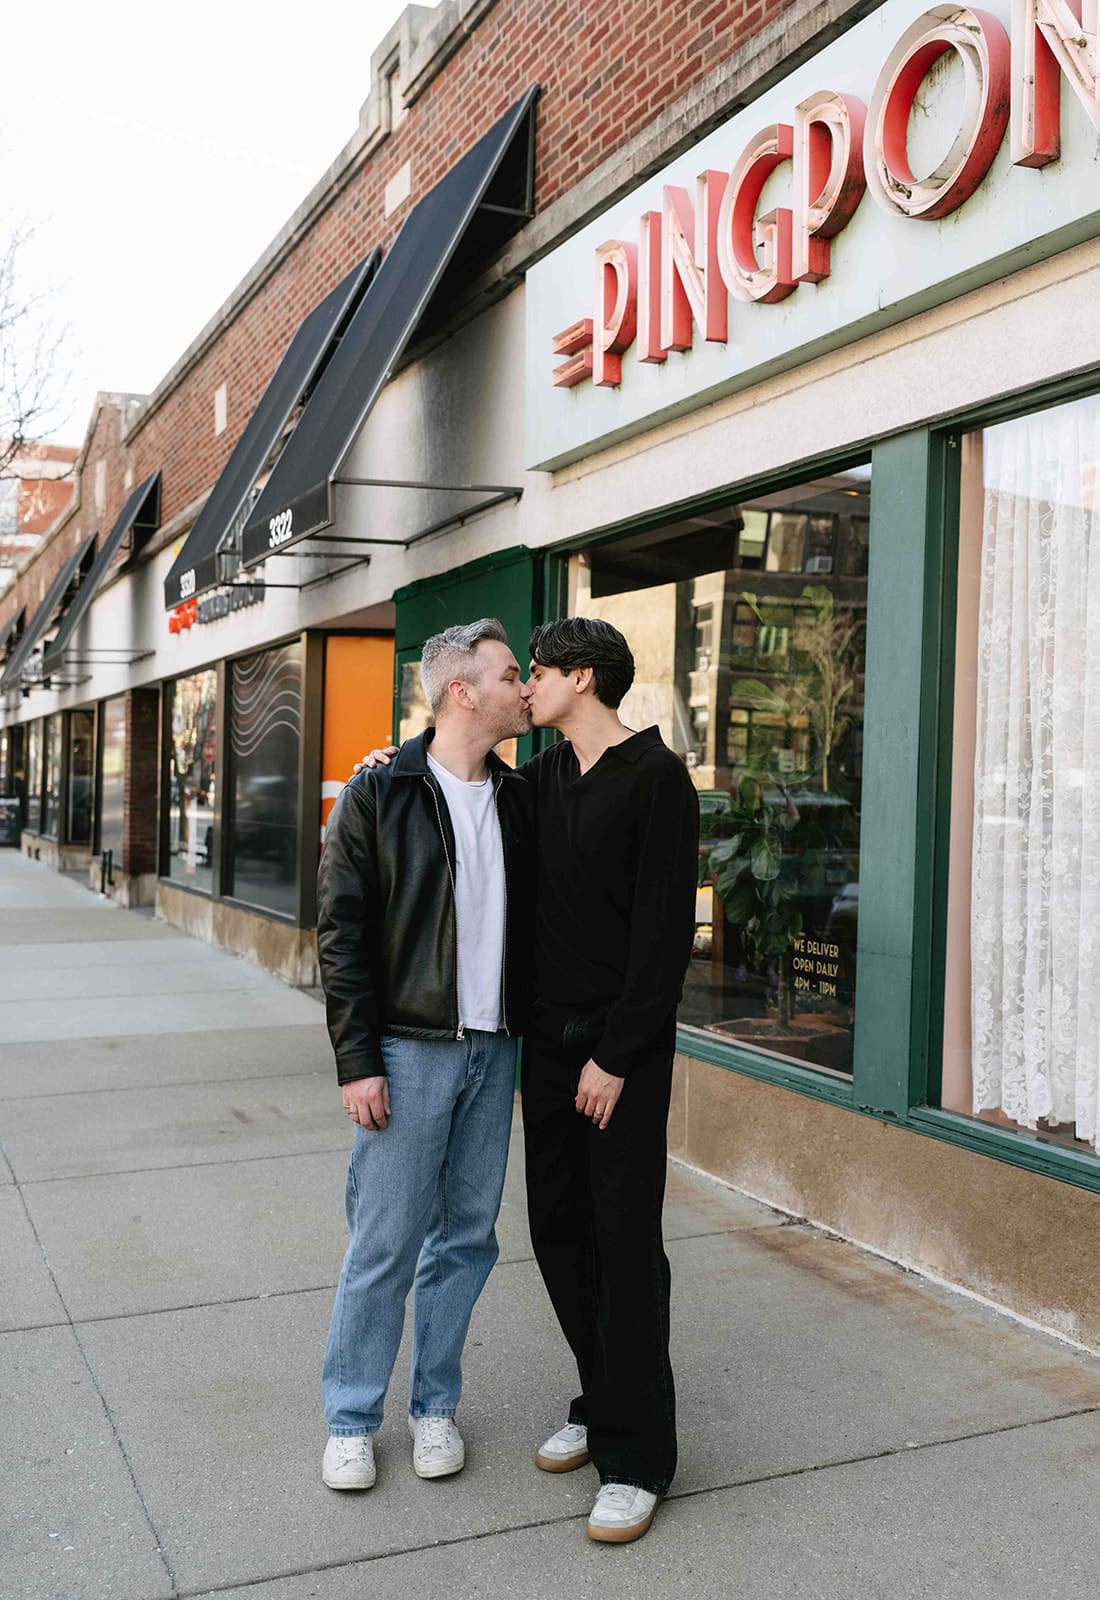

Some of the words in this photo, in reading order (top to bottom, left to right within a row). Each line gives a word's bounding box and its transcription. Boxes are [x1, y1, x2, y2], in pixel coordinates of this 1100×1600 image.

[269, 508, 293, 548] 3322
[793, 938, 805, 952] WE
[807, 941, 839, 958] DELIVER
[792, 957, 814, 972] OPEN
[816, 961, 839, 977] DAILY
[794, 976, 810, 991] 4PM
[819, 980, 836, 997] 11PM
